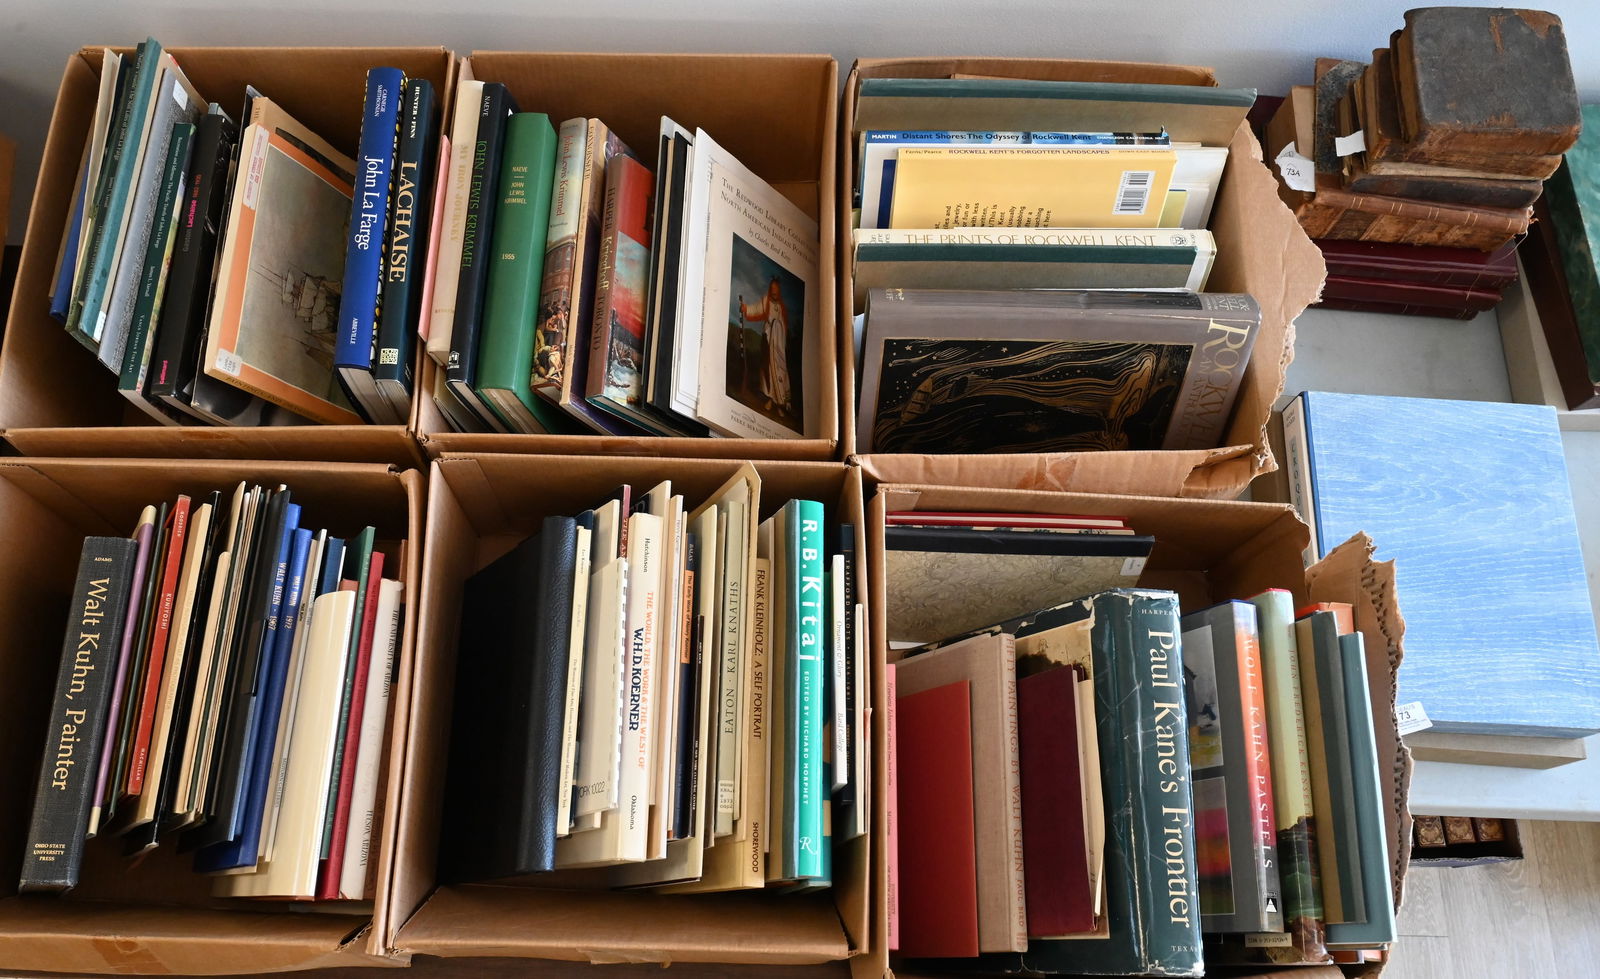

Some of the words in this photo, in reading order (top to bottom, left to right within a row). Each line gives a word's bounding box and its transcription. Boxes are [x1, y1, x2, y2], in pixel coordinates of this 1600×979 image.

[374, 84, 382, 116] SMITHSONIAN
[379, 89, 387, 112] CARNEGIE
[412, 85, 420, 116] HUNTER
[481, 95, 490, 116] NAEVE
[561, 134, 573, 153] John
[584, 126, 594, 179] CONNOISSEUR
[985, 133, 1019, 141] Odyssey
[473, 139, 487, 170] JOHN
[560, 155, 570, 178] Lewis
[360, 155, 384, 188] John
[722, 177, 734, 192] THE
[1286, 167, 1301, 177] 73A
[362, 191, 379, 210] La
[468, 174, 482, 209] LEWIS
[555, 179, 568, 216] Krimmel
[186, 199, 197, 228] Lachaise
[388, 159, 417, 284] LACHAISE
[604, 186, 615, 231] HARPER
[721, 191, 742, 213] NORTH
[743, 208, 771, 234] AMERICAN
[954, 203, 962, 224] jewelry,
[353, 212, 376, 251] Farge
[460, 213, 478, 270] KRIMMEL
[904, 234, 933, 244] THE
[940, 234, 992, 244] PRINTS
[998, 234, 1020, 244] OF
[1025, 235, 1104, 245] ROCKWELL
[1115, 235, 1156, 246] KENT
[349, 317, 358, 344] ABBEVILLE
[592, 293, 605, 350] TORONTO
[642, 537, 651, 572] Hutchinson
[275, 561, 286, 582] WALT
[291, 574, 302, 590] WALT
[755, 569, 765, 599] FRANK
[82, 574, 110, 629] Walt
[271, 584, 283, 605] KUHN
[288, 590, 298, 606] KUHN
[728, 581, 739, 633] KNATHS
[160, 592, 172, 630] KUNIYOSHI
[267, 615, 277, 630] 1967
[283, 614, 293, 629] 1972
[386, 624, 397, 661] UNIVERSITY
[643, 610, 652, 645] WORLD,
[753, 602, 765, 656] KLEINHOLZ:
[64, 628, 100, 703] Kuhn,
[642, 648, 650, 666] THE
[726, 640, 737, 673] KARL
[754, 660, 762, 668] A
[1006, 639, 1014, 672] FIFTY
[1146, 626, 1178, 688] Paul
[1242, 638, 1257, 696] WOLF
[1287, 648, 1297, 680] JOHN
[381, 672, 390, 698] ARIZONA
[641, 668, 649, 694] WORK
[753, 671, 762, 690] SELF
[628, 667, 641, 730] KOERNER
[724, 687, 735, 734] EATON
[803, 705, 808, 715] BY
[639, 706, 647, 724] THE
[751, 692, 762, 739] PORTRAIT
[1007, 680, 1018, 752] PAINTINGS
[1291, 685, 1304, 750] FREDERICK
[1398, 711, 1411, 721] 73
[51, 704, 86, 791] Painter
[638, 726, 647, 753] WEST
[1152, 698, 1186, 794] Kane's
[1249, 706, 1263, 762] KAHN
[135, 748, 145, 780] MACMILLAN
[638, 756, 644, 769] OF
[1010, 759, 1018, 776] BY
[591, 781, 605, 794] 10022
[1011, 784, 1021, 822] WALT
[629, 794, 637, 830] Oklahoma
[1255, 774, 1272, 868] PASTELS
[359, 838, 369, 867] ARIZONA
[751, 821, 759, 872] SHOREWOOD
[1012, 828, 1023, 872] KUHN
[1159, 803, 1198, 930] Frontier
